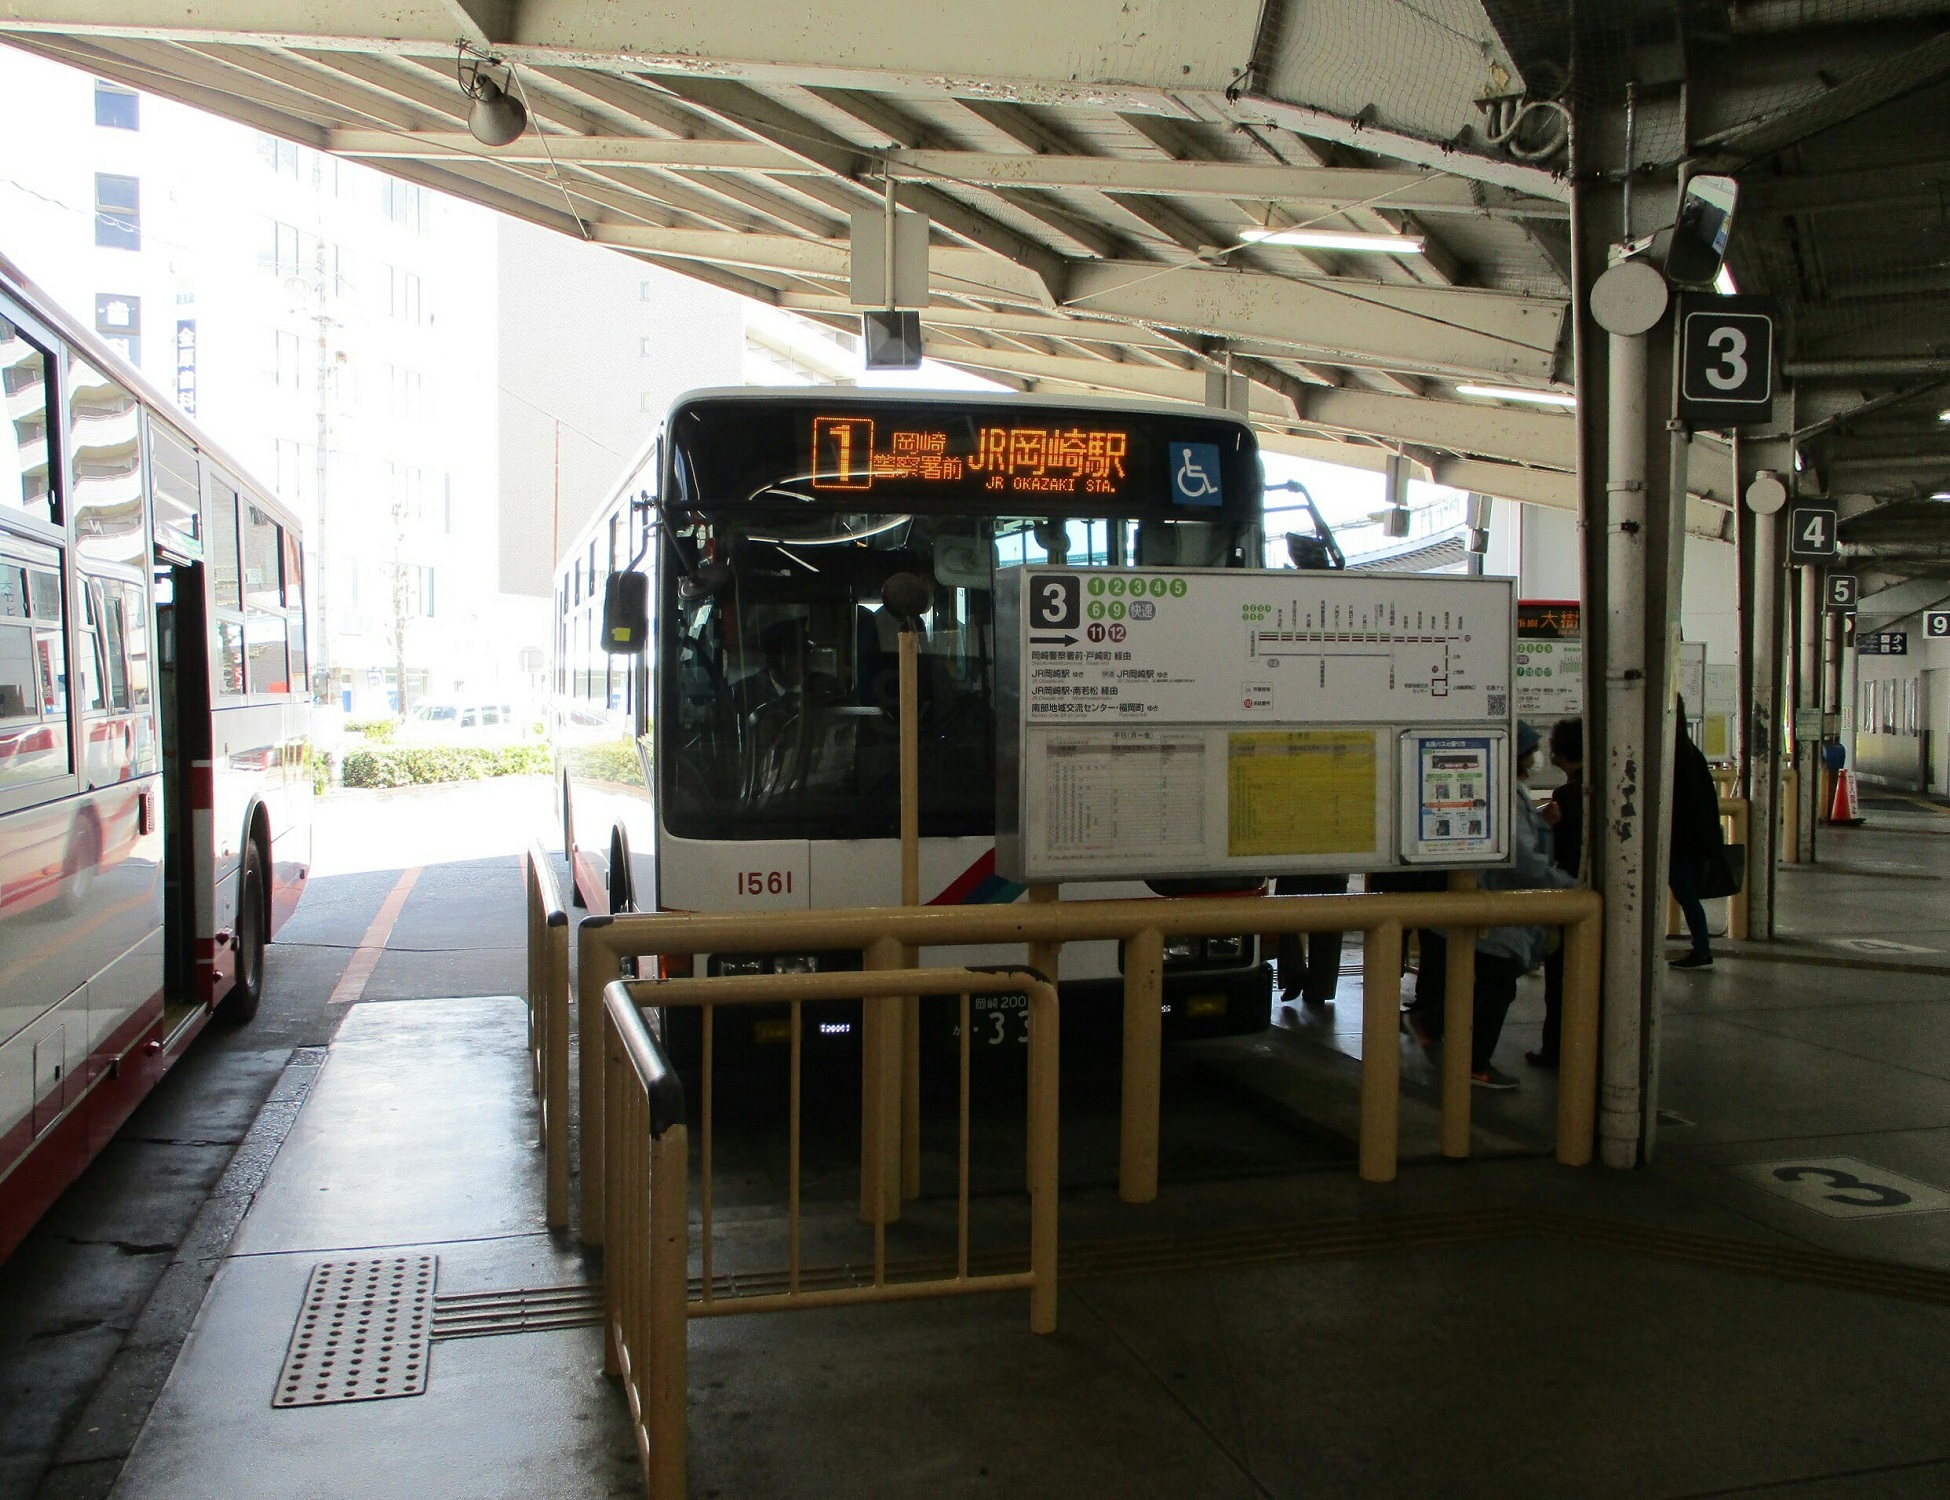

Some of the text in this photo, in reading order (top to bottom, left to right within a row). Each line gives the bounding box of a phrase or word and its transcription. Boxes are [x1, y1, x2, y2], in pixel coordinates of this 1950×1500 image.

[1706, 326, 1748, 390] 3
[893, 432, 946, 454] 岡崎
[829, 425, 850, 482] 1
[968, 428, 1127, 478] JR岡崎駅
[873, 454, 962, 480] 警察署前
[986, 477, 1116, 492] JR OKAZAKI STA.
[1803, 516, 1825, 547] 4
[1114, 581, 1122, 593] 2
[1134, 581, 1142, 593] 3
[1153, 581, 1161, 593] 4
[1174, 582, 1182, 594] 5
[1834, 580, 1849, 601] 5
[1043, 583, 1067, 622] 3
[1130, 604, 1153, 618] 快速
[1090, 627, 1124, 639] 11 12
[1933, 617, 1947, 634] 9
[1114, 651, 1131, 660] 経由
[1032, 669, 1070, 678] JR岡崎駅
[1117, 669, 1154, 679] JR岡崎駅
[1101, 687, 1118, 695] 経由
[738, 871, 793, 895] 1561
[975, 996, 1027, 1010] 岡崎 200
[1772, 1166, 1912, 1207] 3
